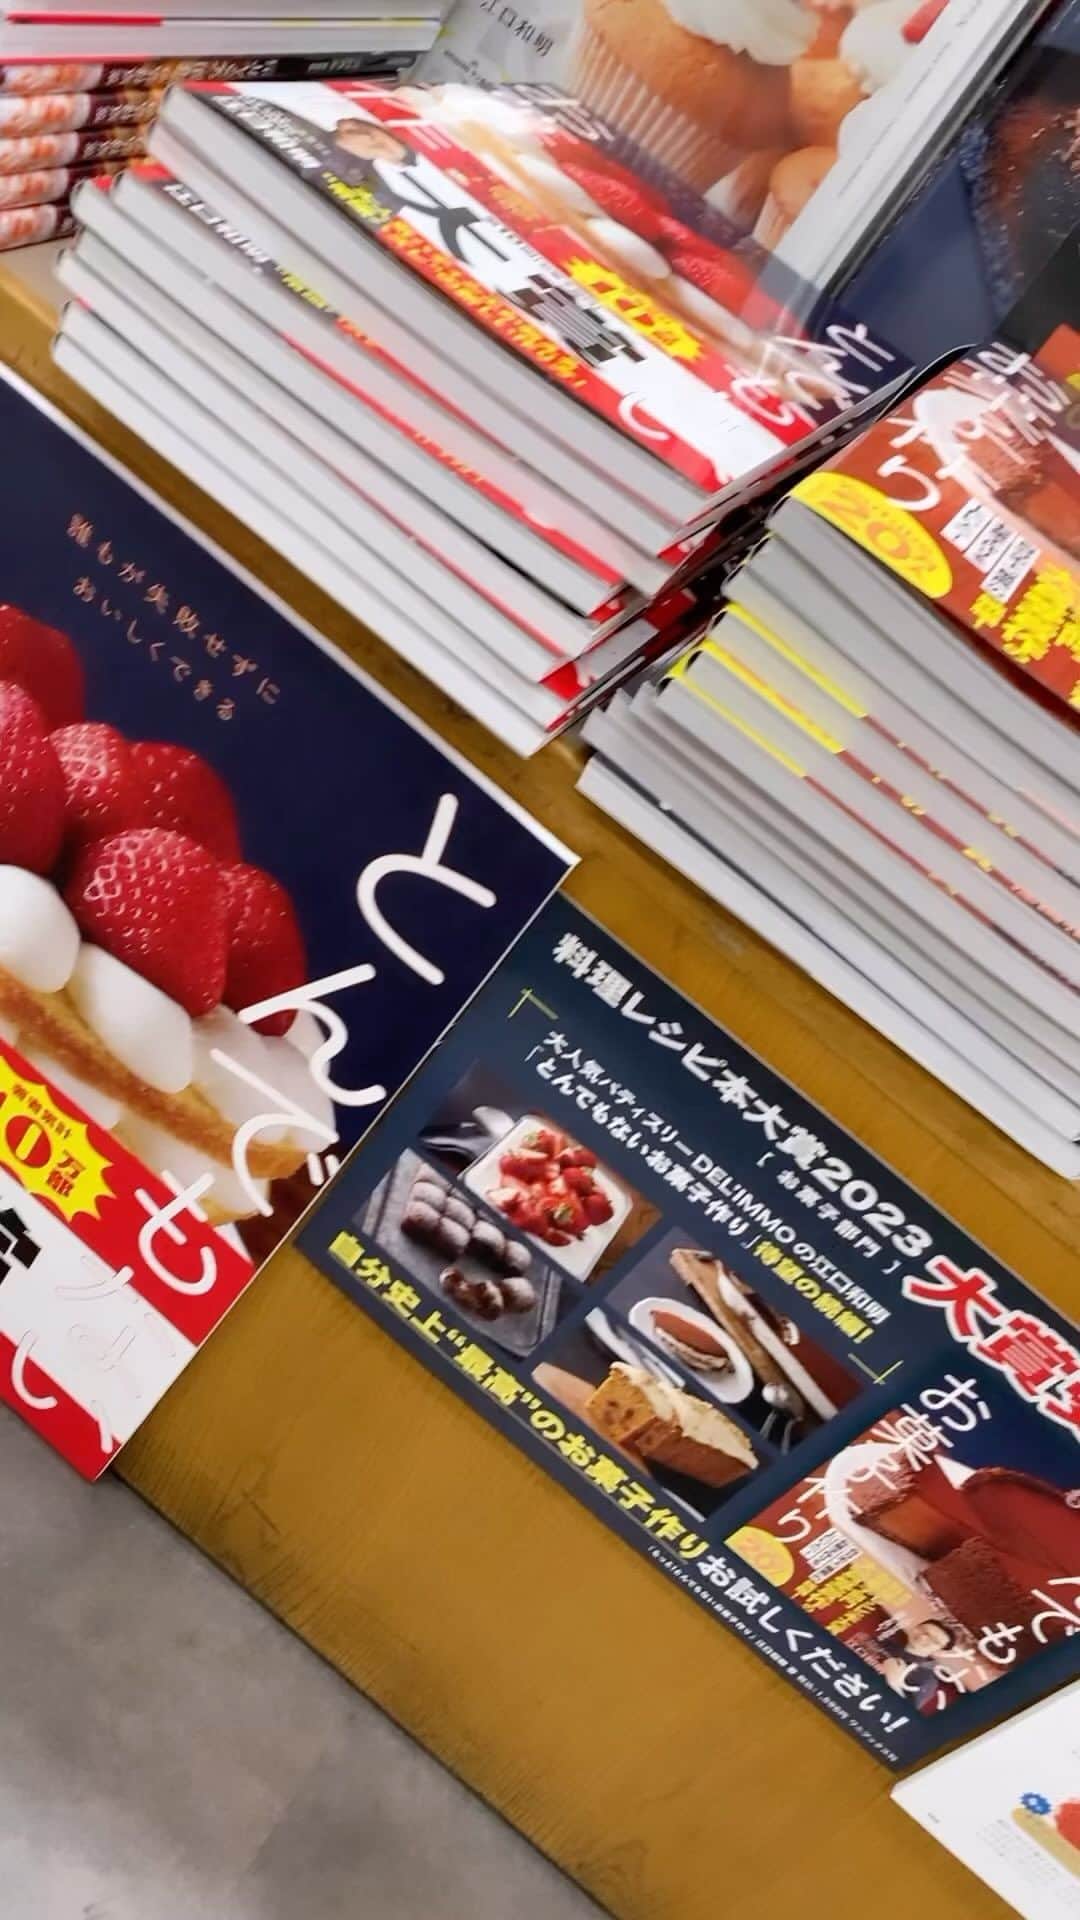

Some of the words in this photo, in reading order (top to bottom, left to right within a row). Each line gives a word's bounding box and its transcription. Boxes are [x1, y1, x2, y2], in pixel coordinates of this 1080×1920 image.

[66, 512, 282, 704] 誰もが失敗せずに
[73, 575, 236, 721] おいしくできる
[0, 1090, 86, 1198] 0万部
[551, 931, 935, 1258] 料理レシピ本大賞2023
